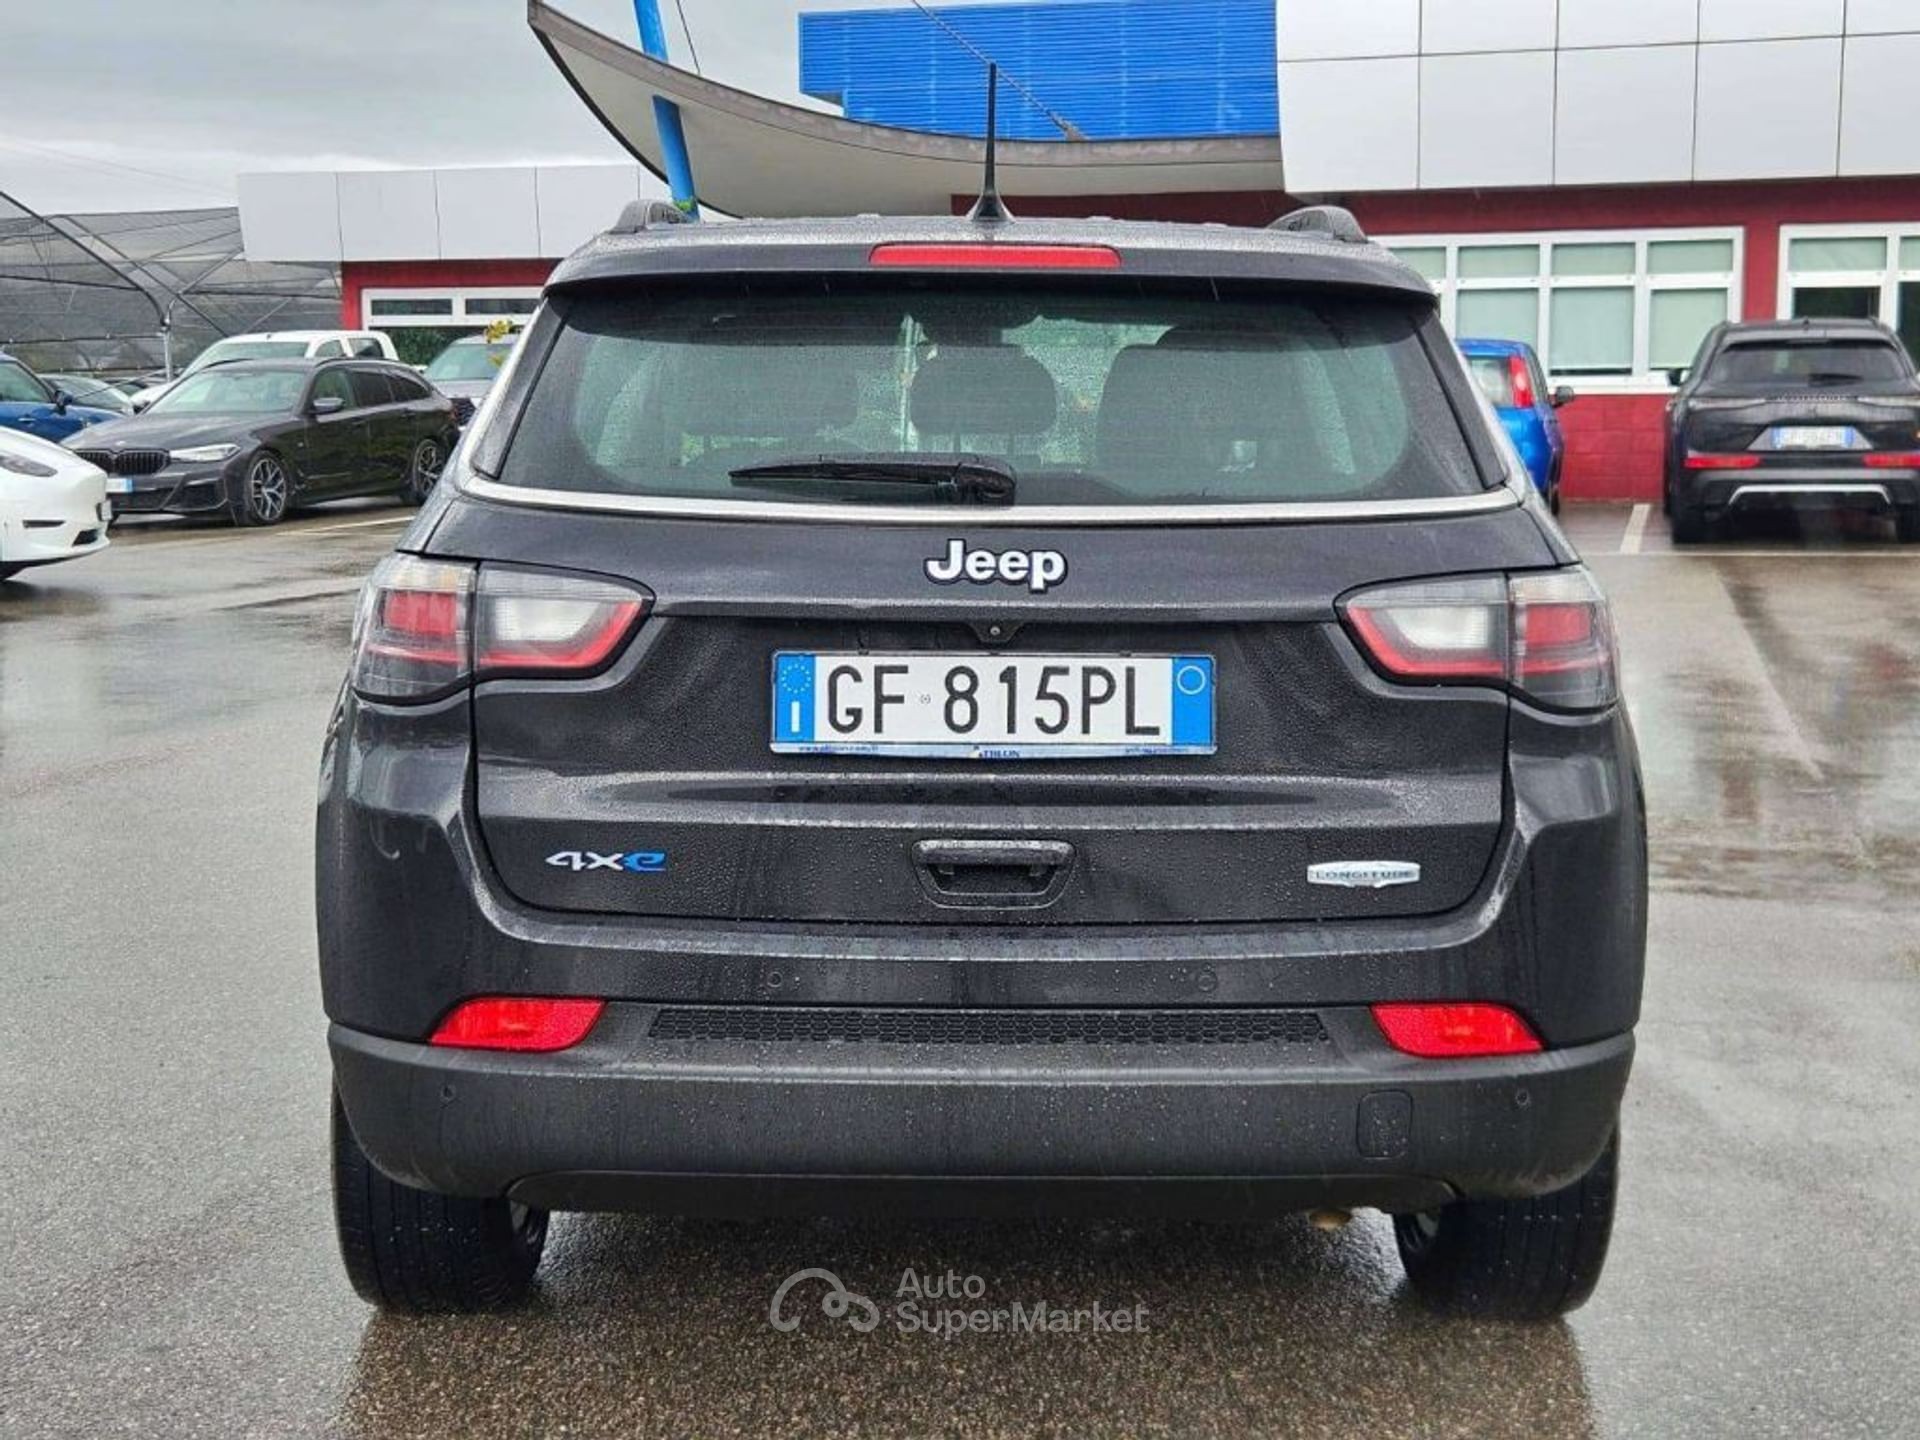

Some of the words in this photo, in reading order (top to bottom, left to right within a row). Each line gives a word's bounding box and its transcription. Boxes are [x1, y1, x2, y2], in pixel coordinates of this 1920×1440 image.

[926, 539, 1066, 591] Jeep
[828, 665, 908, 733] GF
[944, 666, 1160, 735] 815PL
